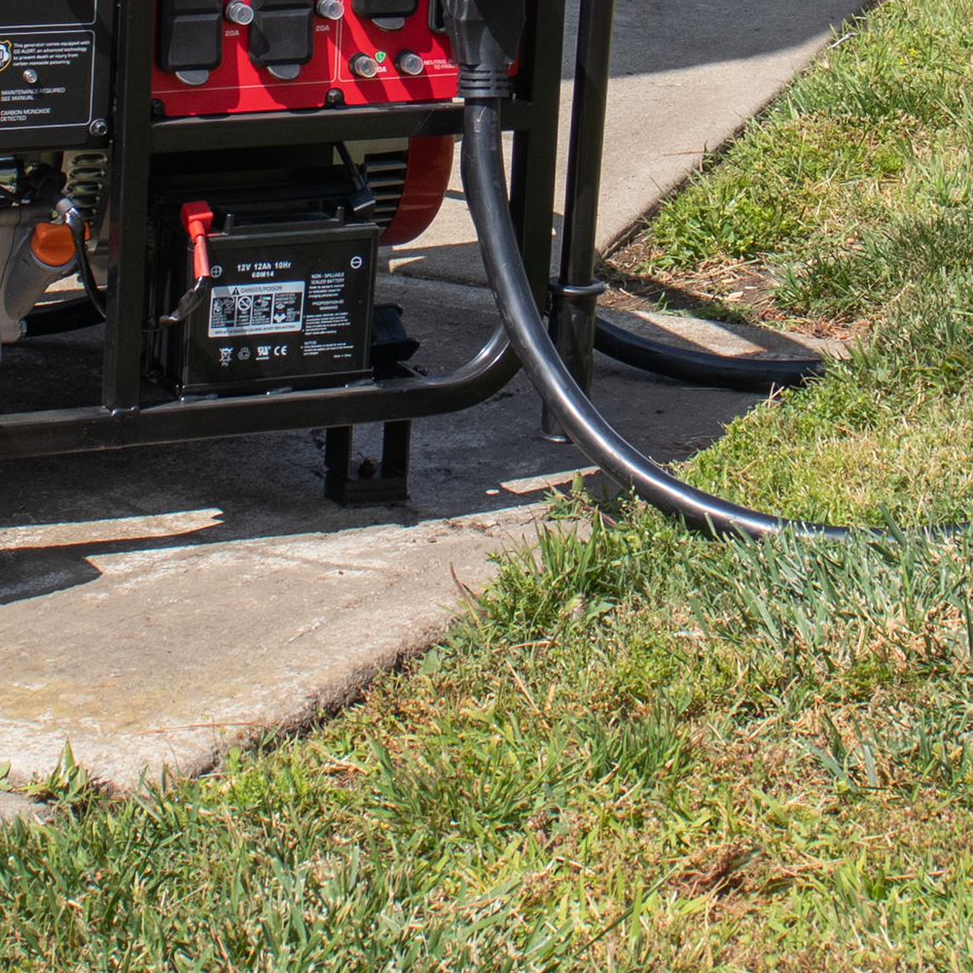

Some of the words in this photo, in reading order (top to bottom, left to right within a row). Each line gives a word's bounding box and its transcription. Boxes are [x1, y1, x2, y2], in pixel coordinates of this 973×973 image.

[0, 88, 39, 96] MAINTENANCE
[236, 263, 252, 272] 12V
[253, 262, 272, 271] 12Ah
[274, 261, 292, 270] 10Hr
[240, 285, 283, 294] DANGER/POISON
